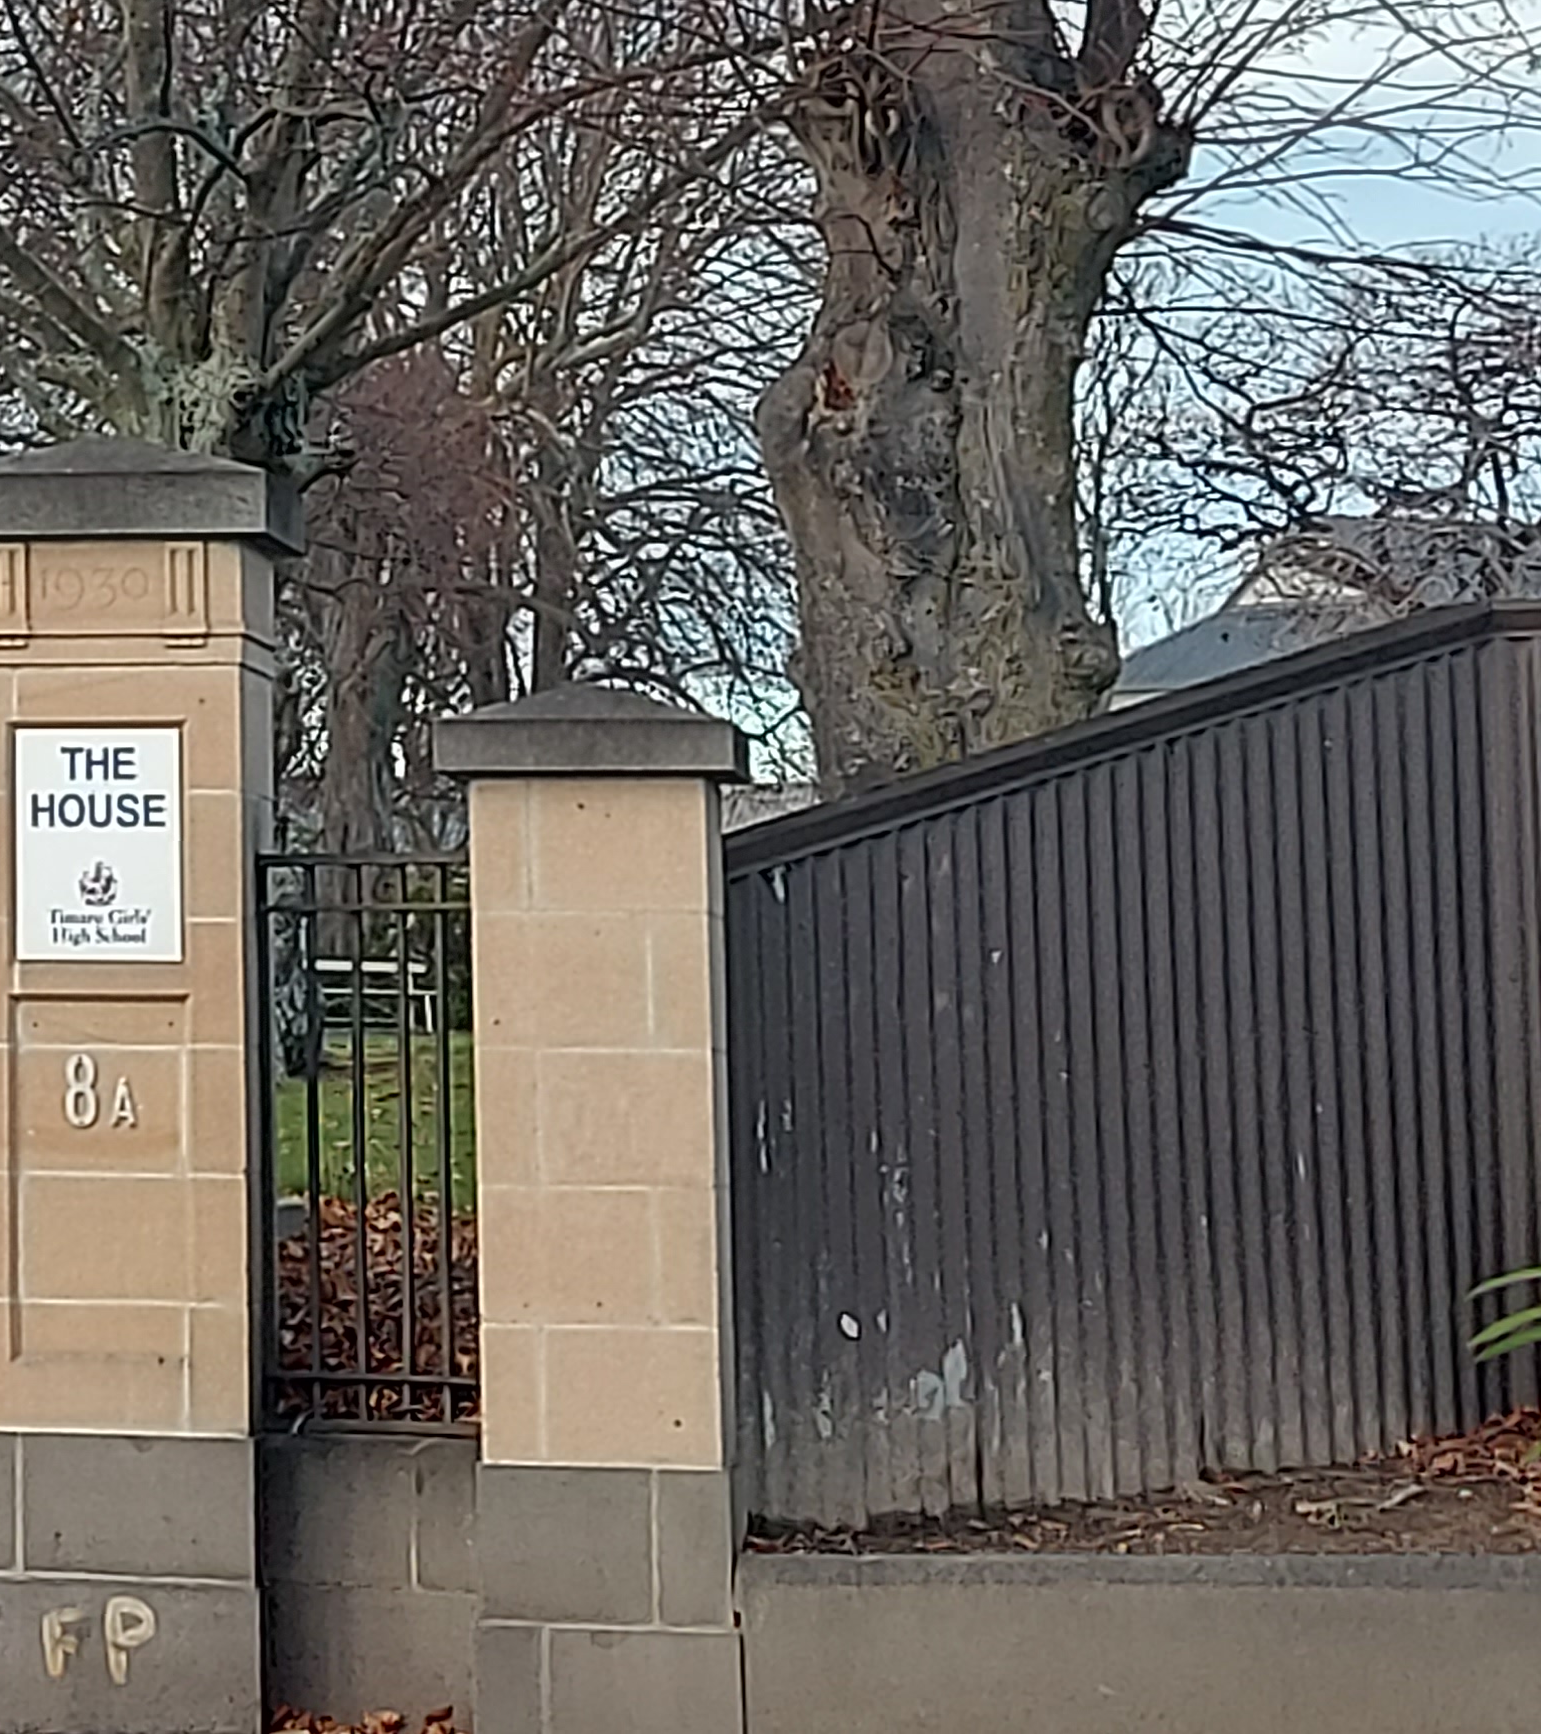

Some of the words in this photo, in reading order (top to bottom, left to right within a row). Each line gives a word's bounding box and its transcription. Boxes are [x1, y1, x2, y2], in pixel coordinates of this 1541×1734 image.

[40, 567, 149, 611] 1930
[60, 746, 138, 781] THE
[30, 793, 167, 828] HOUSE
[53, 926, 91, 947] High
[95, 925, 146, 944] School
